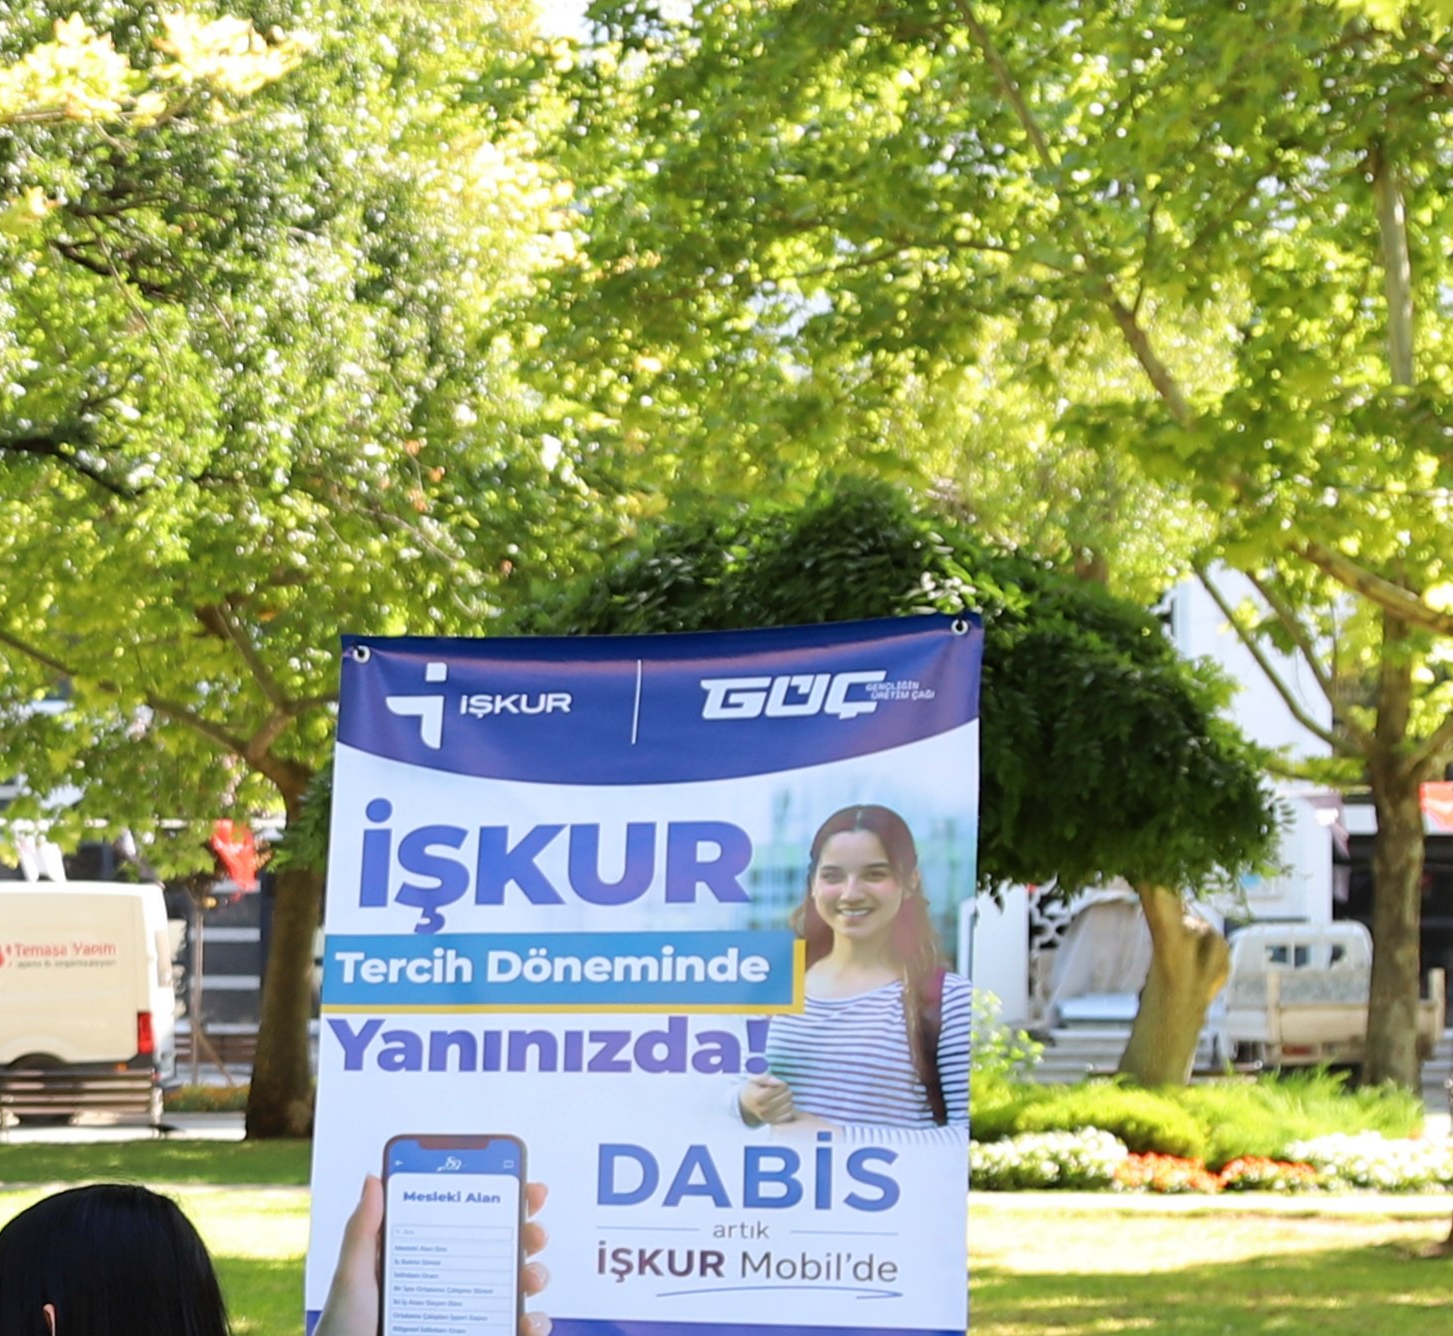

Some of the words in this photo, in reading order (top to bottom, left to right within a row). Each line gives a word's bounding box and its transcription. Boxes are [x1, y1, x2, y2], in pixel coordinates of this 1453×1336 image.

[358, 797, 753, 934] İŞKUR
[334, 947, 473, 984] Tercih
[486, 945, 770, 983] Döneminde
[327, 1016, 777, 1075] Yanınızda!
[597, 1131, 900, 1212] DABİS
[402, 1190, 462, 1203] Mesleki
[464, 1191, 501, 1204] Alan
[712, 1220, 770, 1240] artık
[597, 1240, 725, 1283] İŞKUR
